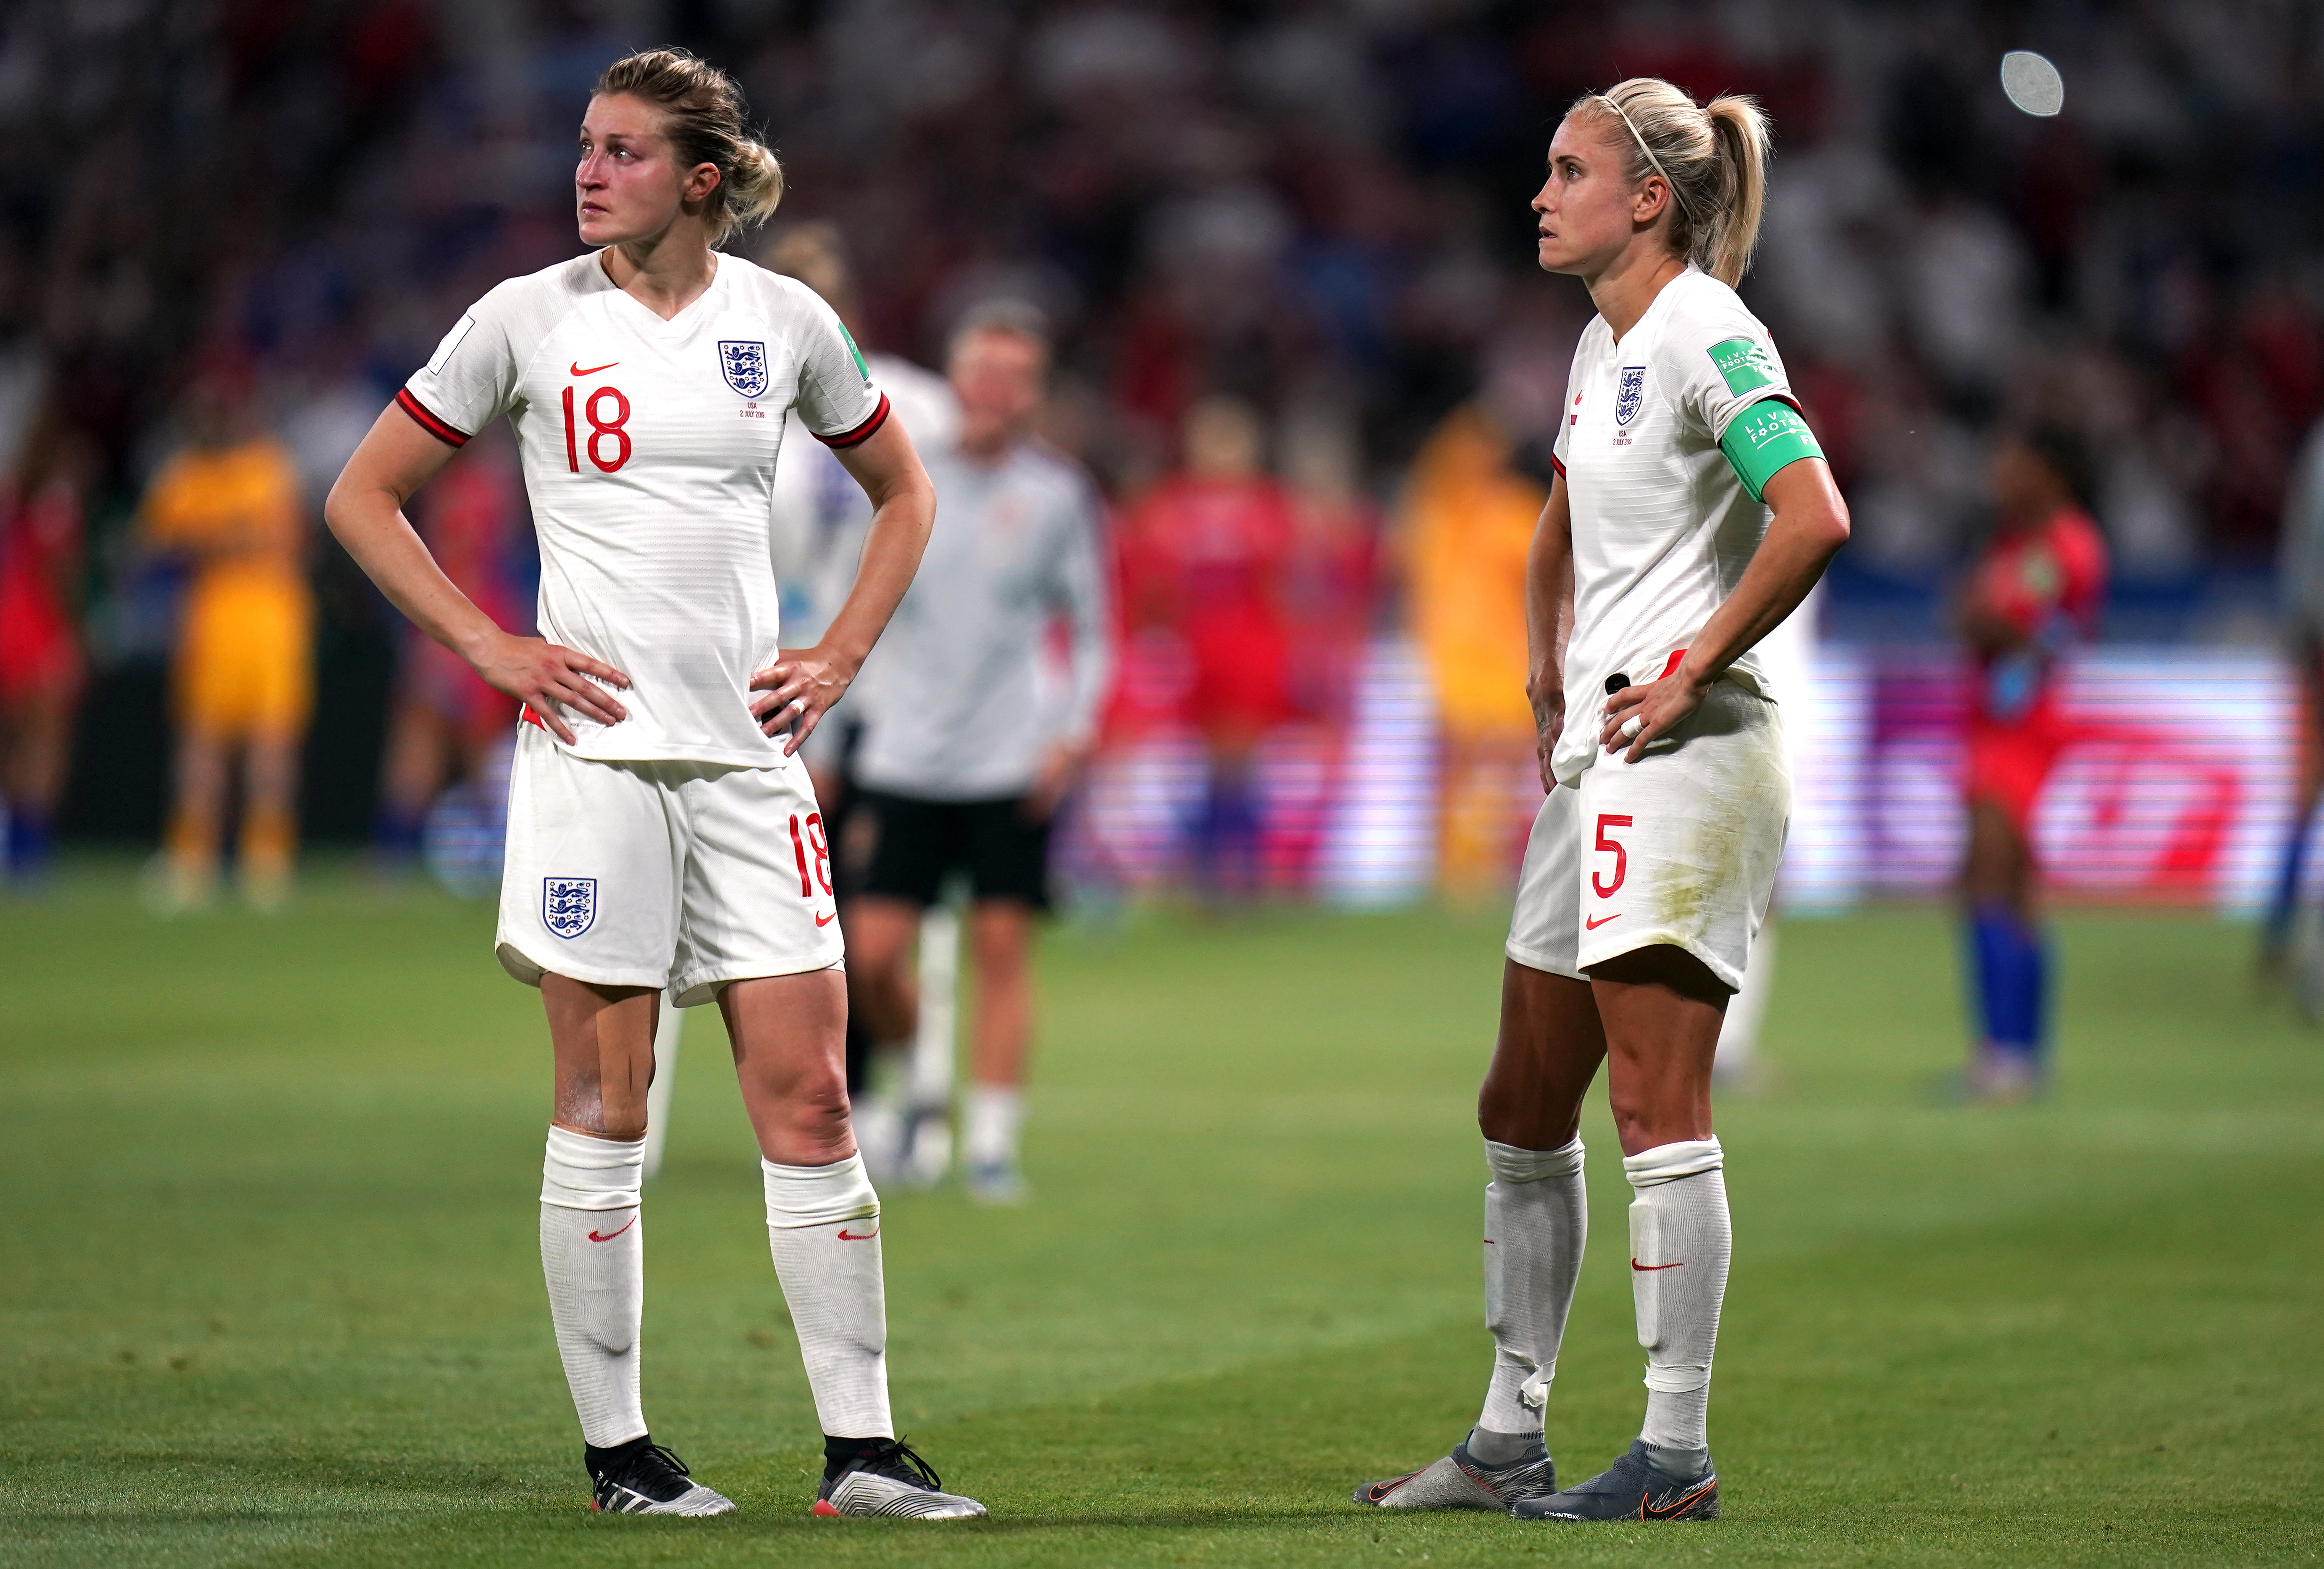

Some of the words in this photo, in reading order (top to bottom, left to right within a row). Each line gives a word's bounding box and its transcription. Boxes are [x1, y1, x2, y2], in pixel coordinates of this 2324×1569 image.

[1719, 349, 1755, 363] LIVIN
[562, 386, 631, 473] 18
[1745, 410, 1799, 434] LIVI
[1750, 418, 1806, 444] FOOTBA
[789, 812, 832, 897] 18
[1592, 814, 1633, 899] 5
